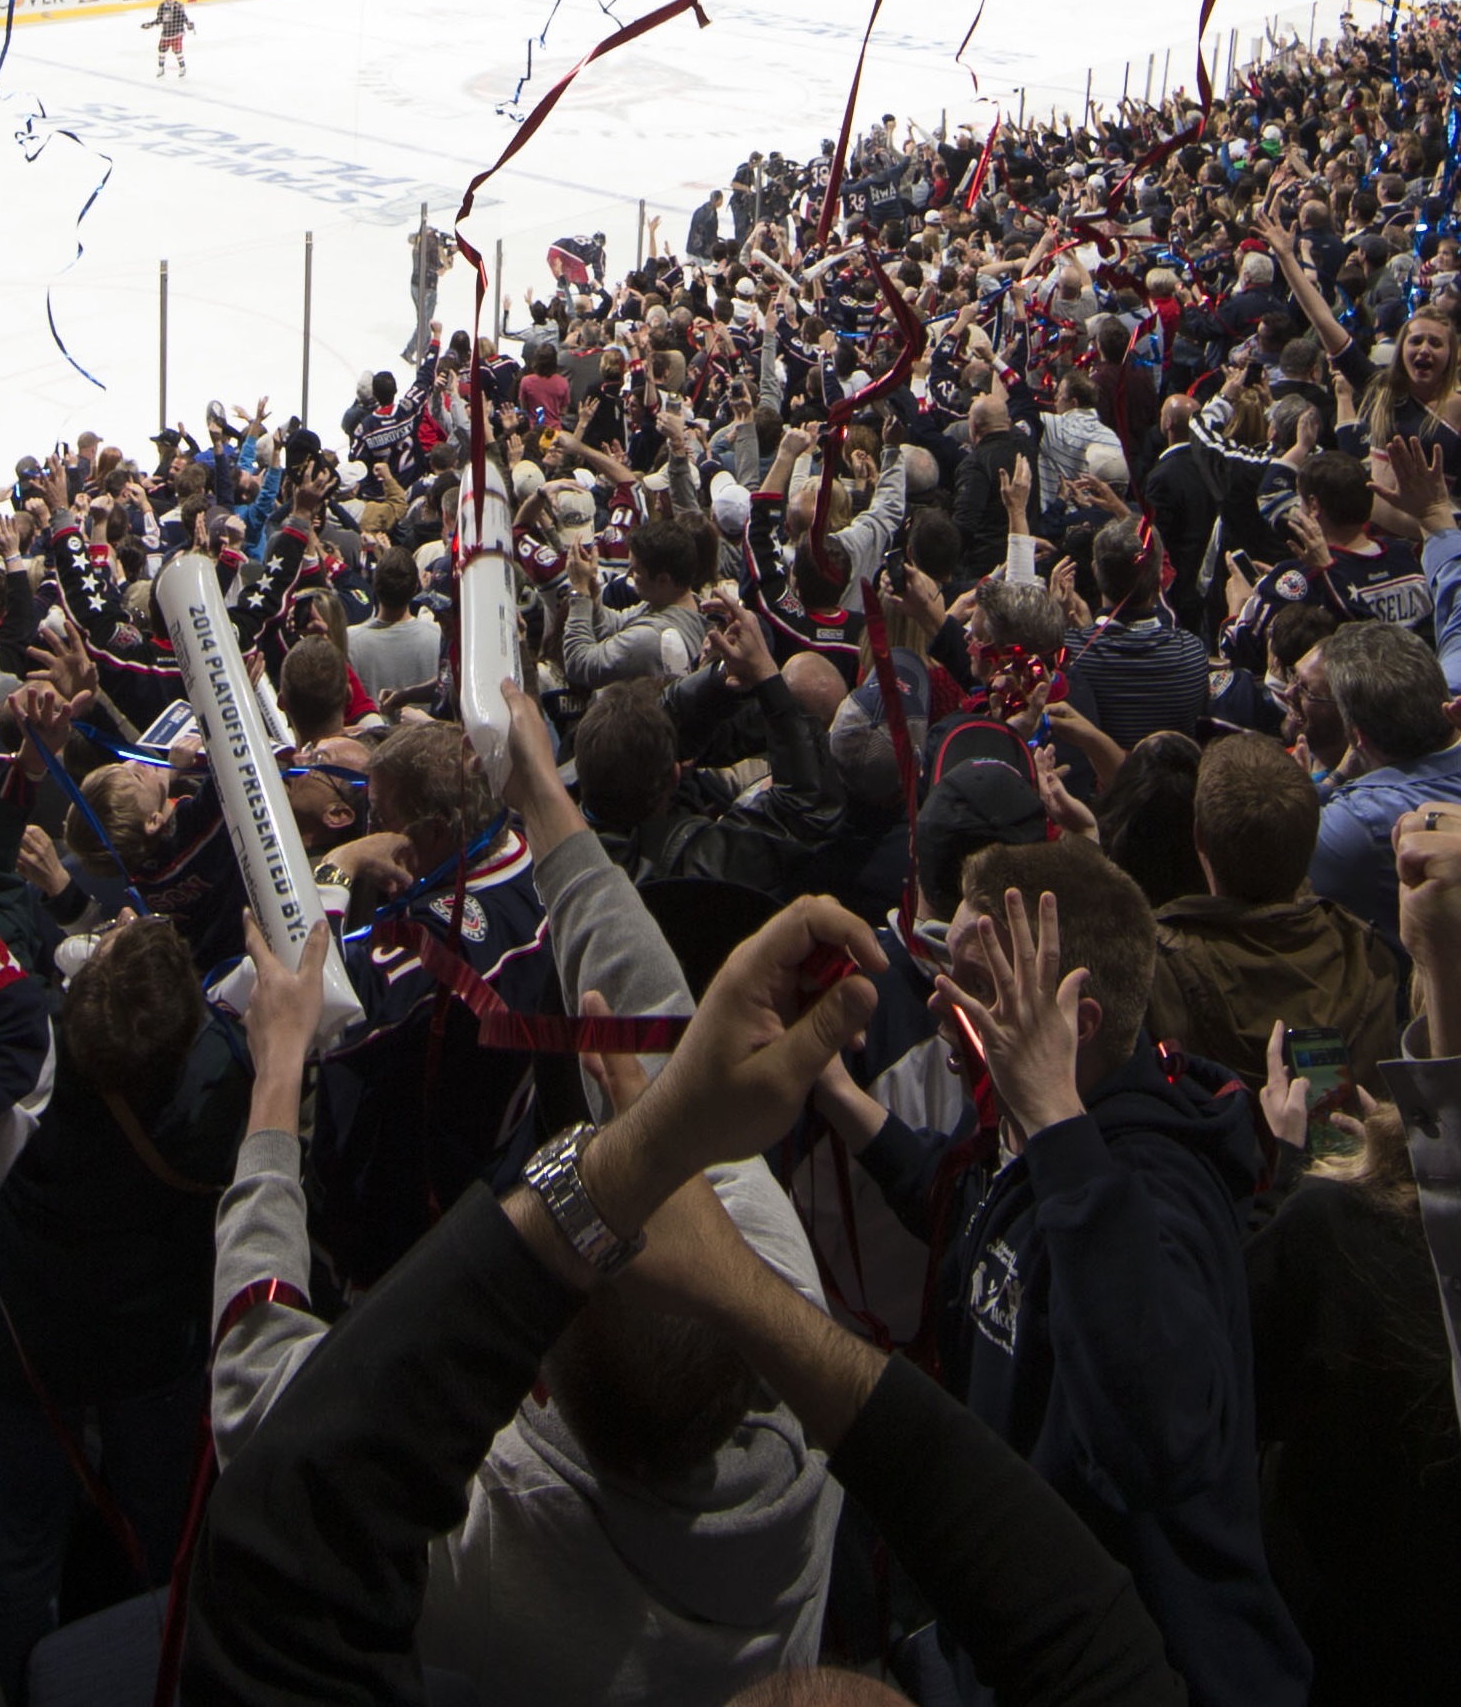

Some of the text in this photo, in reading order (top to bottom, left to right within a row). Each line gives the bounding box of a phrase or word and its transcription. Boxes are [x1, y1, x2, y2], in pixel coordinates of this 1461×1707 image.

[60, 103, 416, 189] PLAYOFFS
[117, 141, 386, 204] STANLEY
[188, 604, 216, 652] 2014
[204, 655, 251, 760] PLAYOFFS
[238, 761, 295, 895] PRESENTED
[280, 897, 308, 944] BY:
